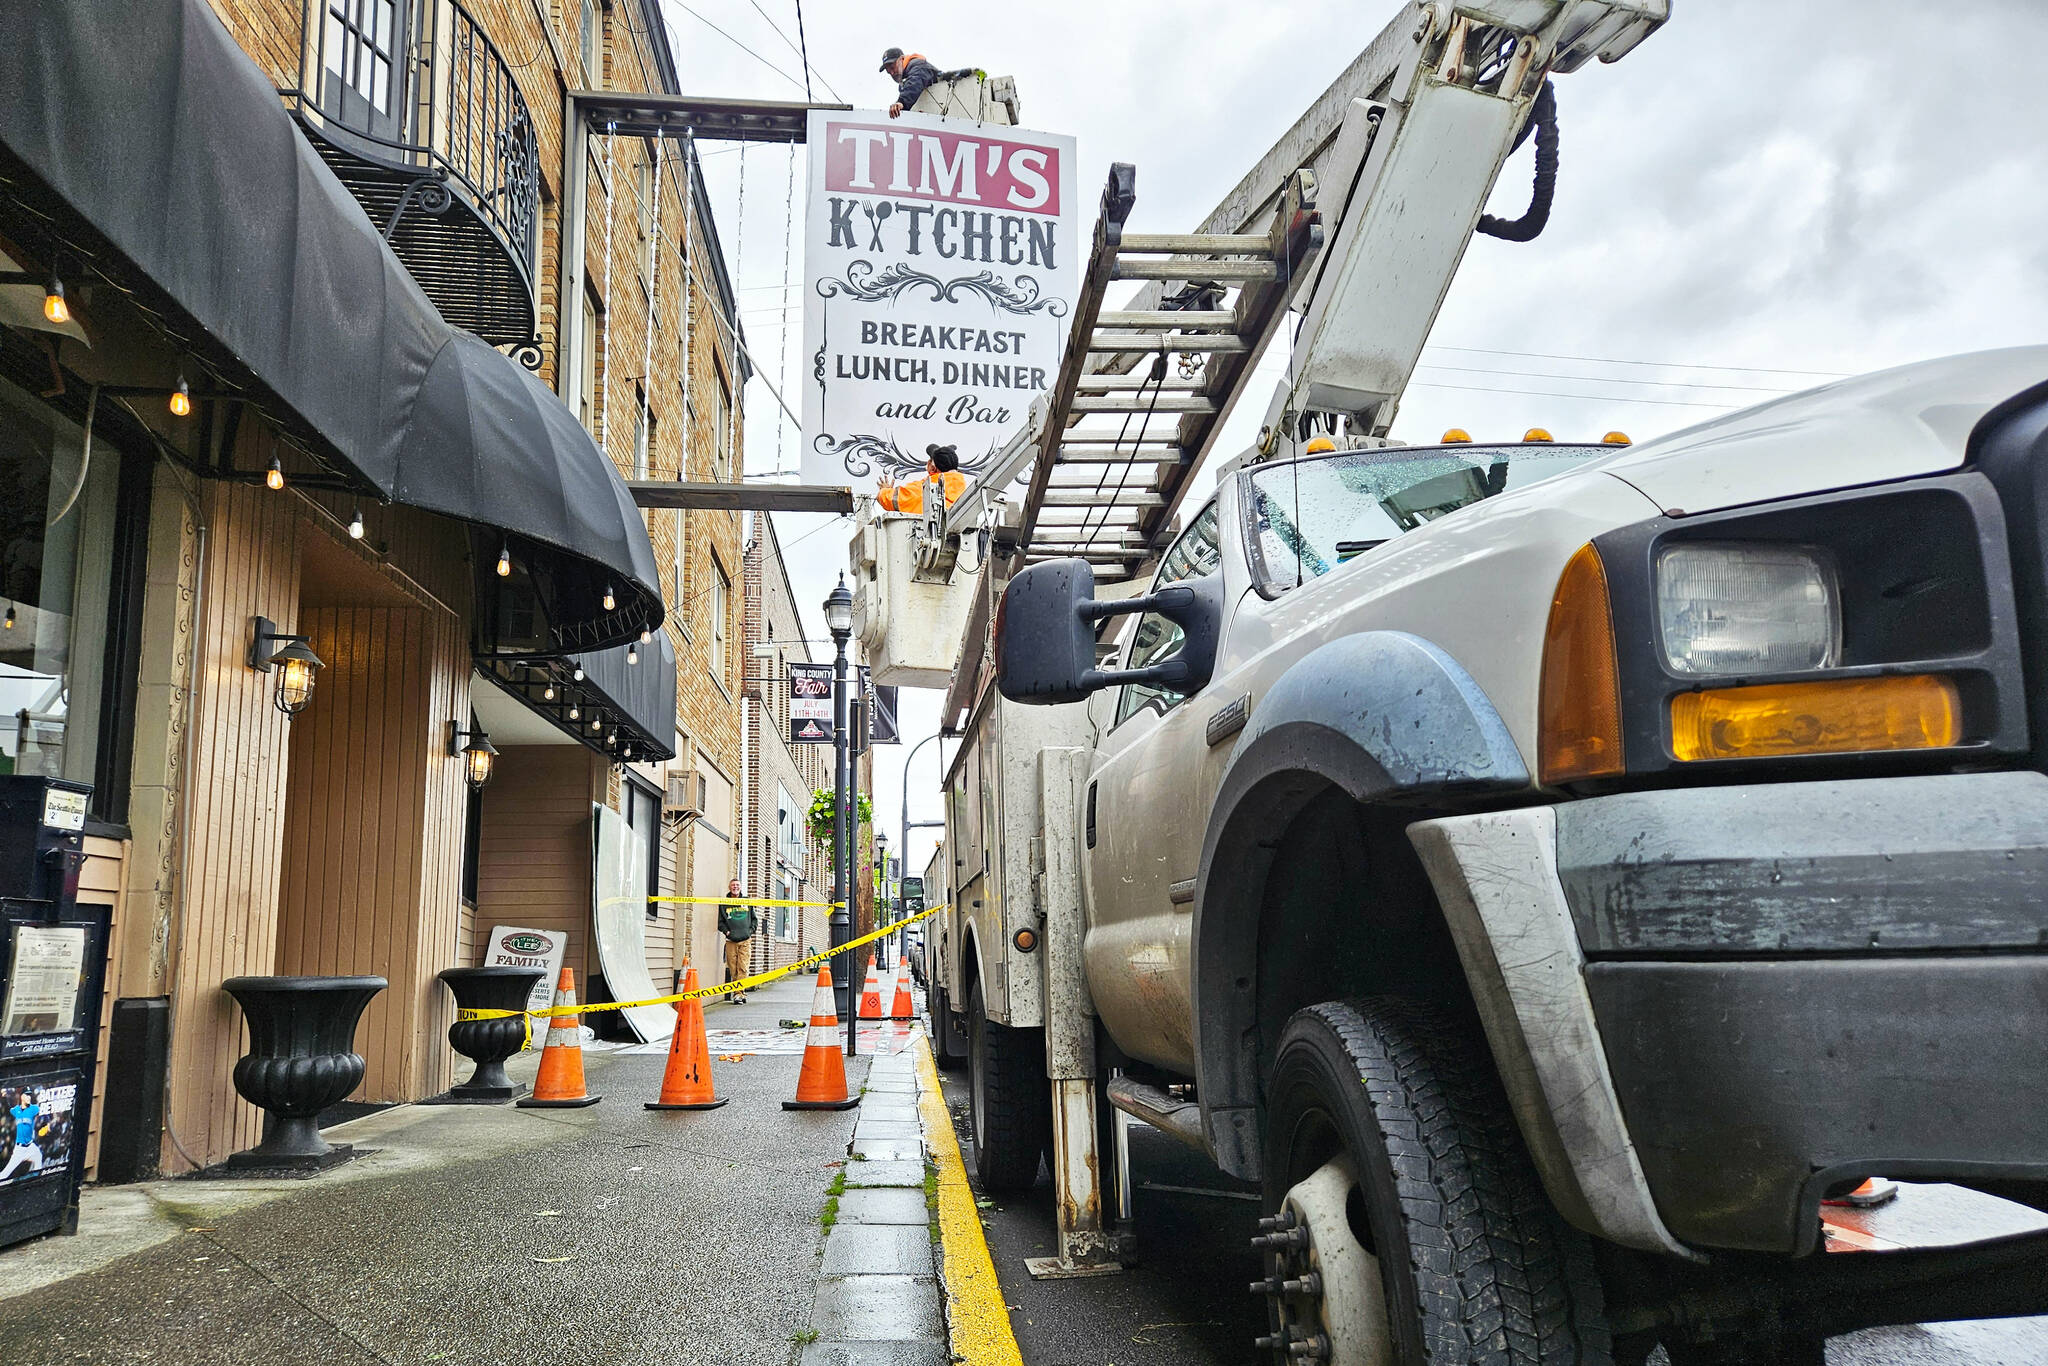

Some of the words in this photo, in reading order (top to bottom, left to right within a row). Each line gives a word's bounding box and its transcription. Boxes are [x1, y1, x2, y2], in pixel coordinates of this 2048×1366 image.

[837, 128, 1050, 209] TIM'S
[860, 319, 1026, 355] BREAKFAST
[835, 354, 937, 386] LUNCH,
[942, 361, 1048, 391] DINNER
[875, 396, 937, 421] and
[945, 393, 1011, 425] Bar
[791, 668, 806, 678] KING
[807, 669, 832, 679] COUNTY
[794, 677, 829, 695] Fair
[803, 700, 819, 708] JULY
[495, 954, 550, 968] FAMILY
